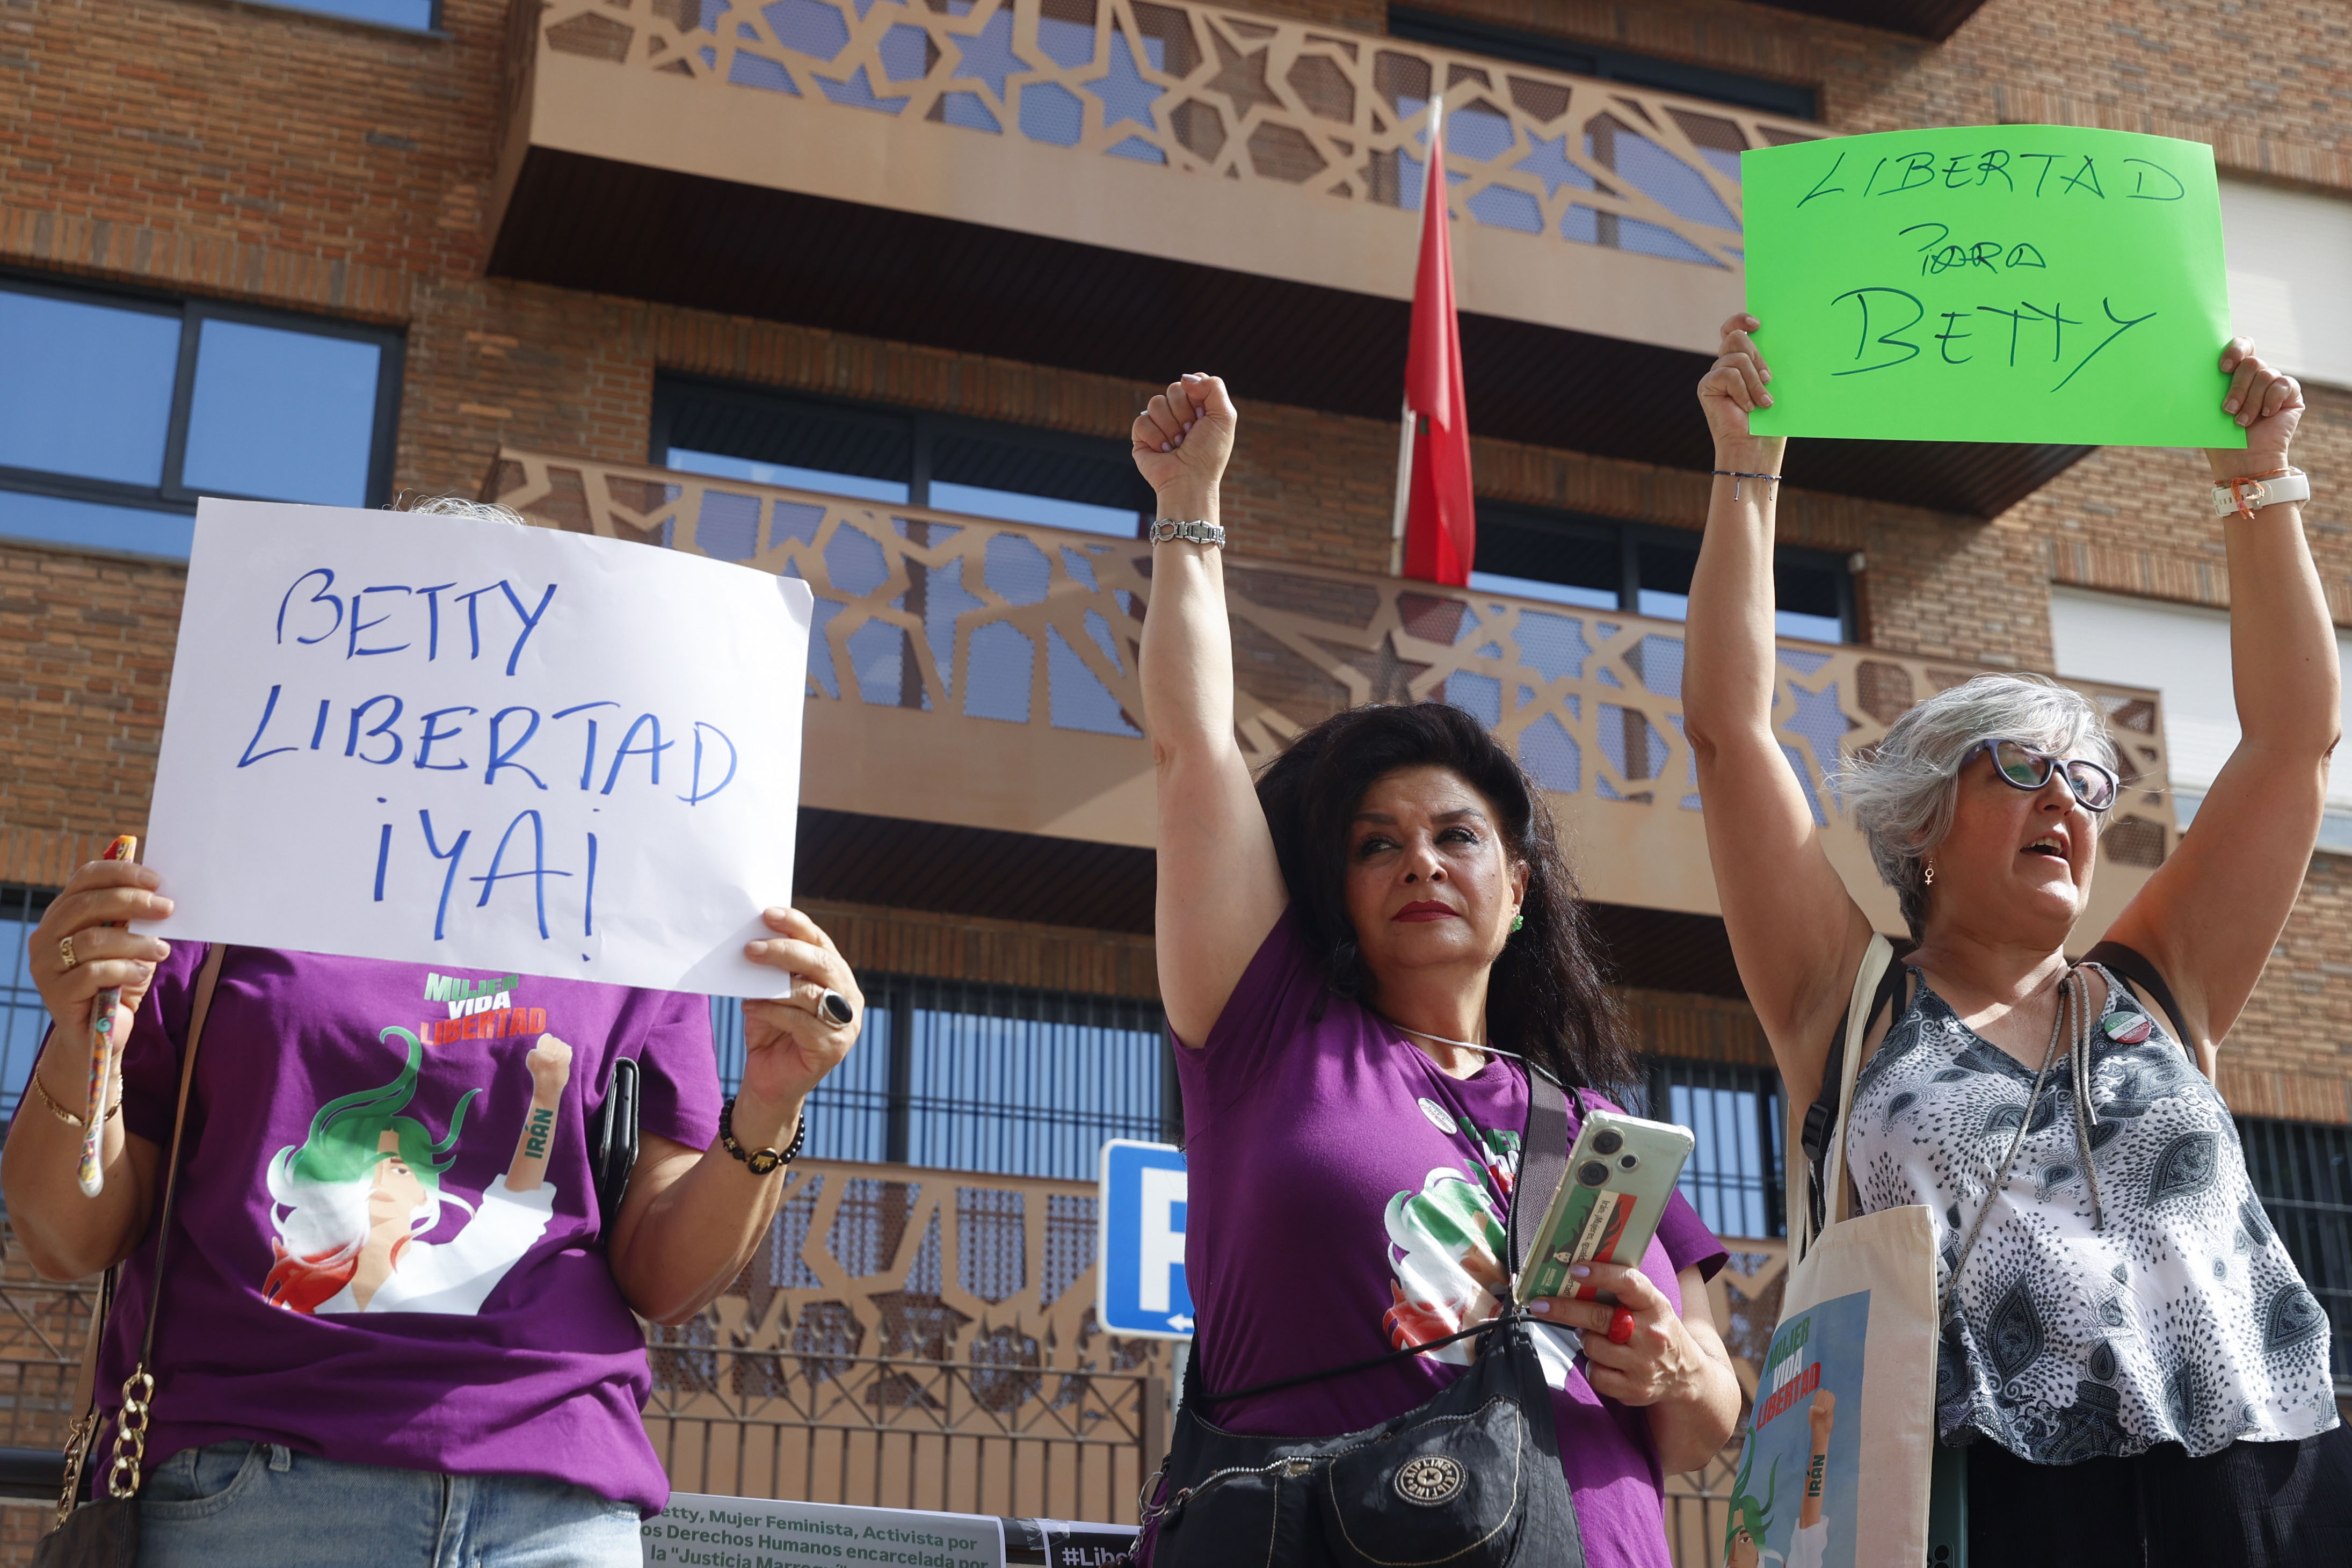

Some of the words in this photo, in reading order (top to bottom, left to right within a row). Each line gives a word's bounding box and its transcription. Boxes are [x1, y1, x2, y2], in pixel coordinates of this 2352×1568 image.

[1796, 149, 2186, 208] LIBERTAD
[1830, 287, 2158, 393] BETTY
[277, 567, 558, 677] BETTY
[236, 685, 738, 807] LIBERTAD
[424, 972, 519, 1001] MUJER
[448, 990, 511, 1020] VIDA
[420, 1007, 547, 1046] LIBERTAD
[2109, 1014, 2132, 1028] MUJER
[2121, 1021, 2137, 1032] VIDA
[2121, 1023, 2148, 1041] LIBERTAD
[525, 1108, 554, 1159] IRÁN
[1766, 1316, 1811, 1378] MUJER
[1772, 1346, 1803, 1395] VIDA
[1756, 1361, 1821, 1432] LIBERTAD
[1405, 1459, 1451, 1478] KIPLING
[1806, 1454, 1826, 1497] IRÁN
[660, 1506, 705, 1523] etty,
[709, 1509, 762, 1528] Mujer
[766, 1515, 858, 1540] Feminista,
[862, 1526, 943, 1547] Activista
[948, 1538, 978, 1551] por
[667, 1525, 754, 1547] Derechos
[759, 1534, 842, 1557] Humanos
[846, 1546, 954, 1568] encarcelada
[651, 1544, 666, 1561] la
[671, 1547, 752, 1568] "Justicia
